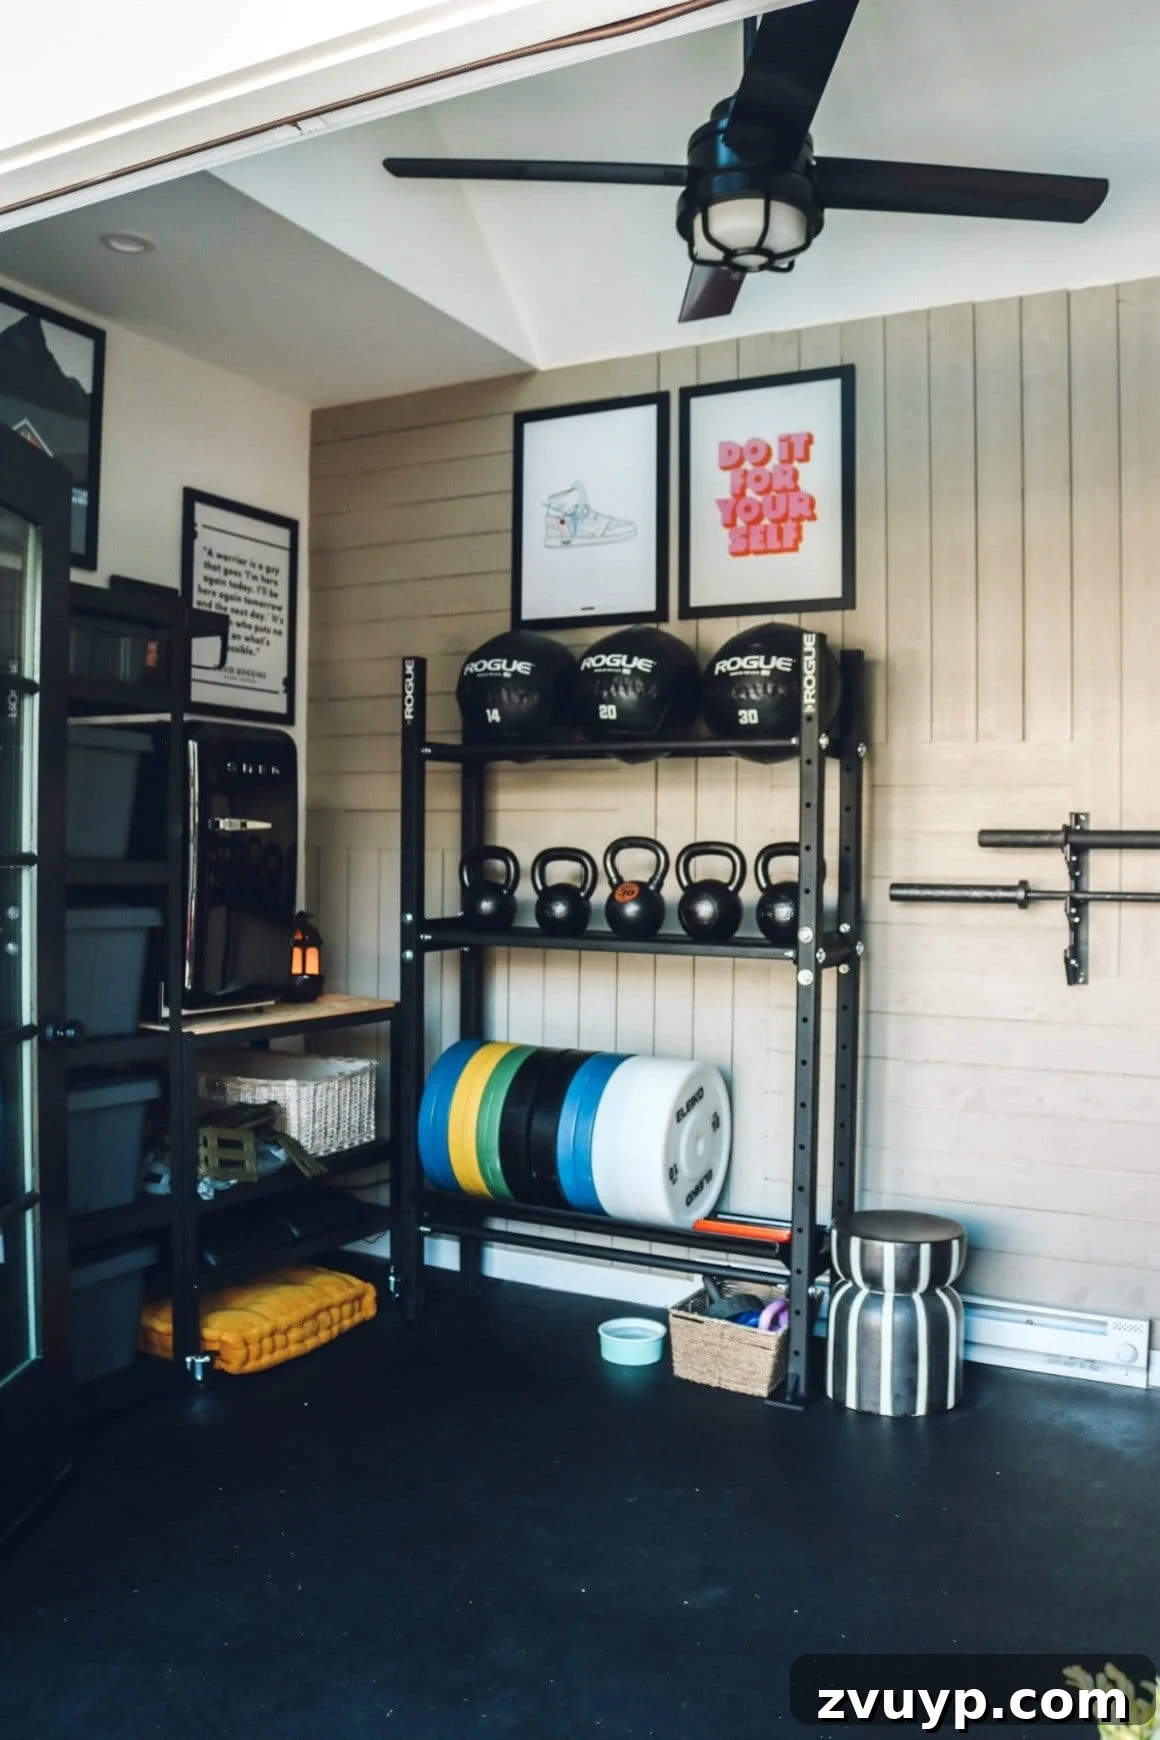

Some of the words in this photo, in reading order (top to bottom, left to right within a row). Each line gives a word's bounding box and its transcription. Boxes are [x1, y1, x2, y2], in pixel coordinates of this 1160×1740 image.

[718, 438, 772, 471] DO
[730, 464, 800, 497] FOR
[716, 492, 817, 528] YOUR
[729, 523, 803, 557] SELF
[203, 560, 221, 572] that
[261, 574, 278, 586] here
[265, 565, 279, 576] guy
[197, 584, 217, 597] here
[219, 592, 242, 603] again
[244, 596, 283, 611] tomorrow
[203, 575, 226, 586] again
[269, 589, 278, 599] be
[196, 600, 212, 609] and
[215, 601, 228, 612] the
[230, 607, 248, 616] next
[235, 620, 252, 630] who
[254, 625, 271, 634] puts
[273, 628, 282, 636] no
[463, 658, 532, 676] ROGUE
[580, 654, 653, 674] ROGUE
[714, 655, 793, 676] ROGUE
[805, 633, 816, 704] ROGUE
[404, 658, 415, 720] ROGUE
[486, 708, 500, 723] 14
[599, 705, 617, 720] 20
[738, 709, 759, 725] 30
[676, 1086, 704, 1124] ELEIKO
